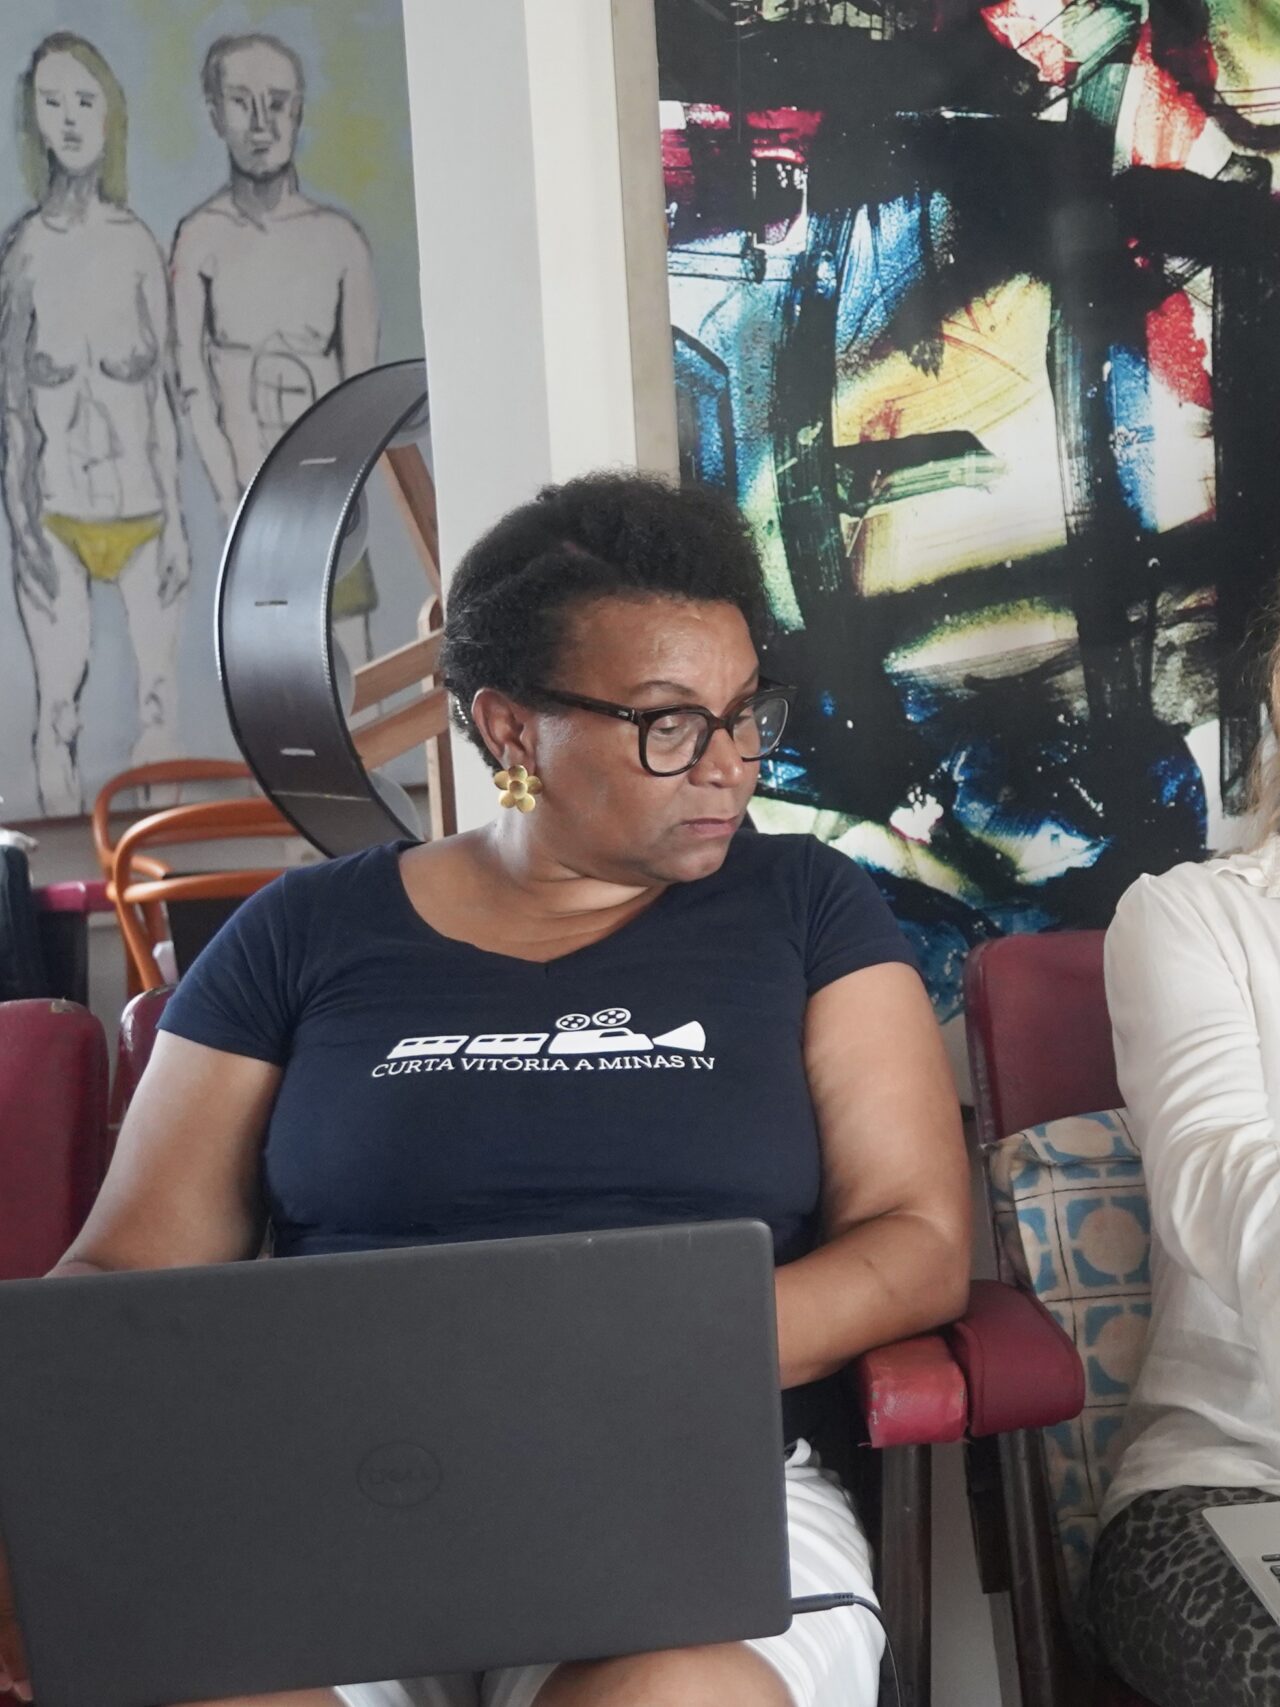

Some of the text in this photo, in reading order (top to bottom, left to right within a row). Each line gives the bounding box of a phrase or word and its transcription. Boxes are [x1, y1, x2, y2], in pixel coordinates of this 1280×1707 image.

[372, 1054, 716, 1078] CURTA VITÓRIA A MINAS IV
